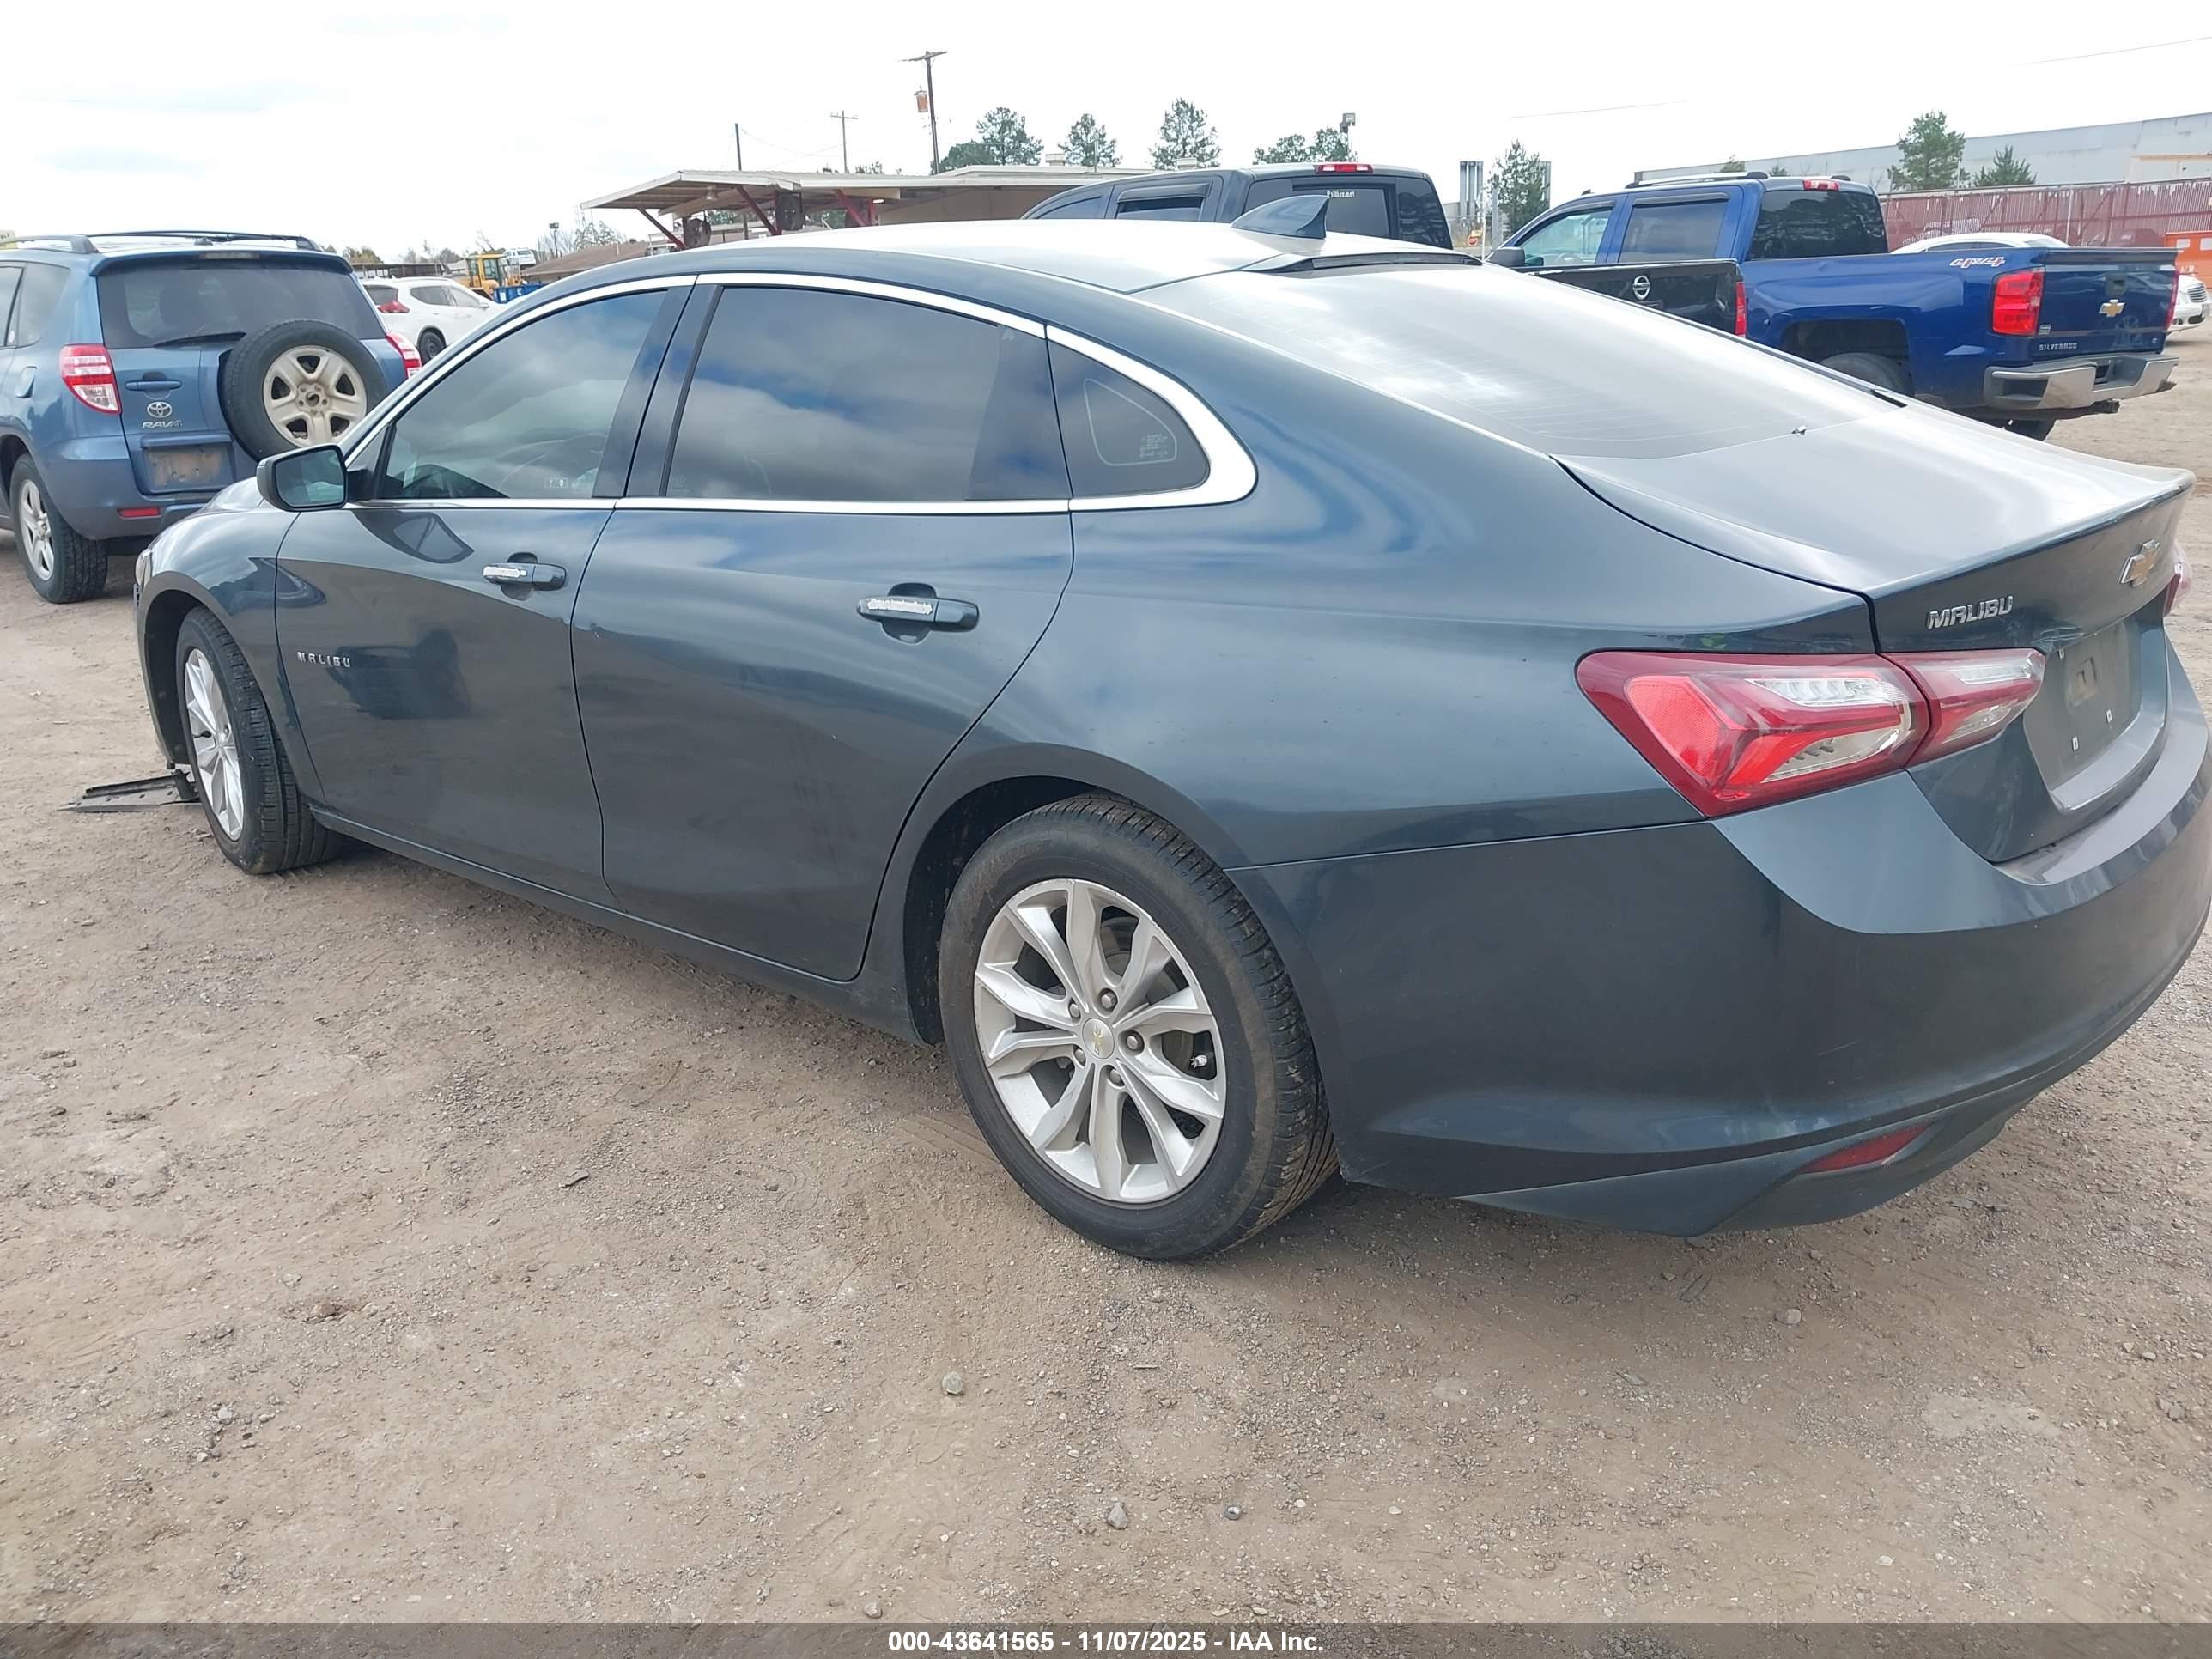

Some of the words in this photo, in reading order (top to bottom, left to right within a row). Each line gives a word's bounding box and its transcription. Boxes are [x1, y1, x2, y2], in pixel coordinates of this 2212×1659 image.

[2039, 342, 2078, 351] SILVERADO
[142, 419, 183, 429] RAV4
[1927, 595, 2014, 629] MALIBU
[296, 651, 351, 668] MALIBU
